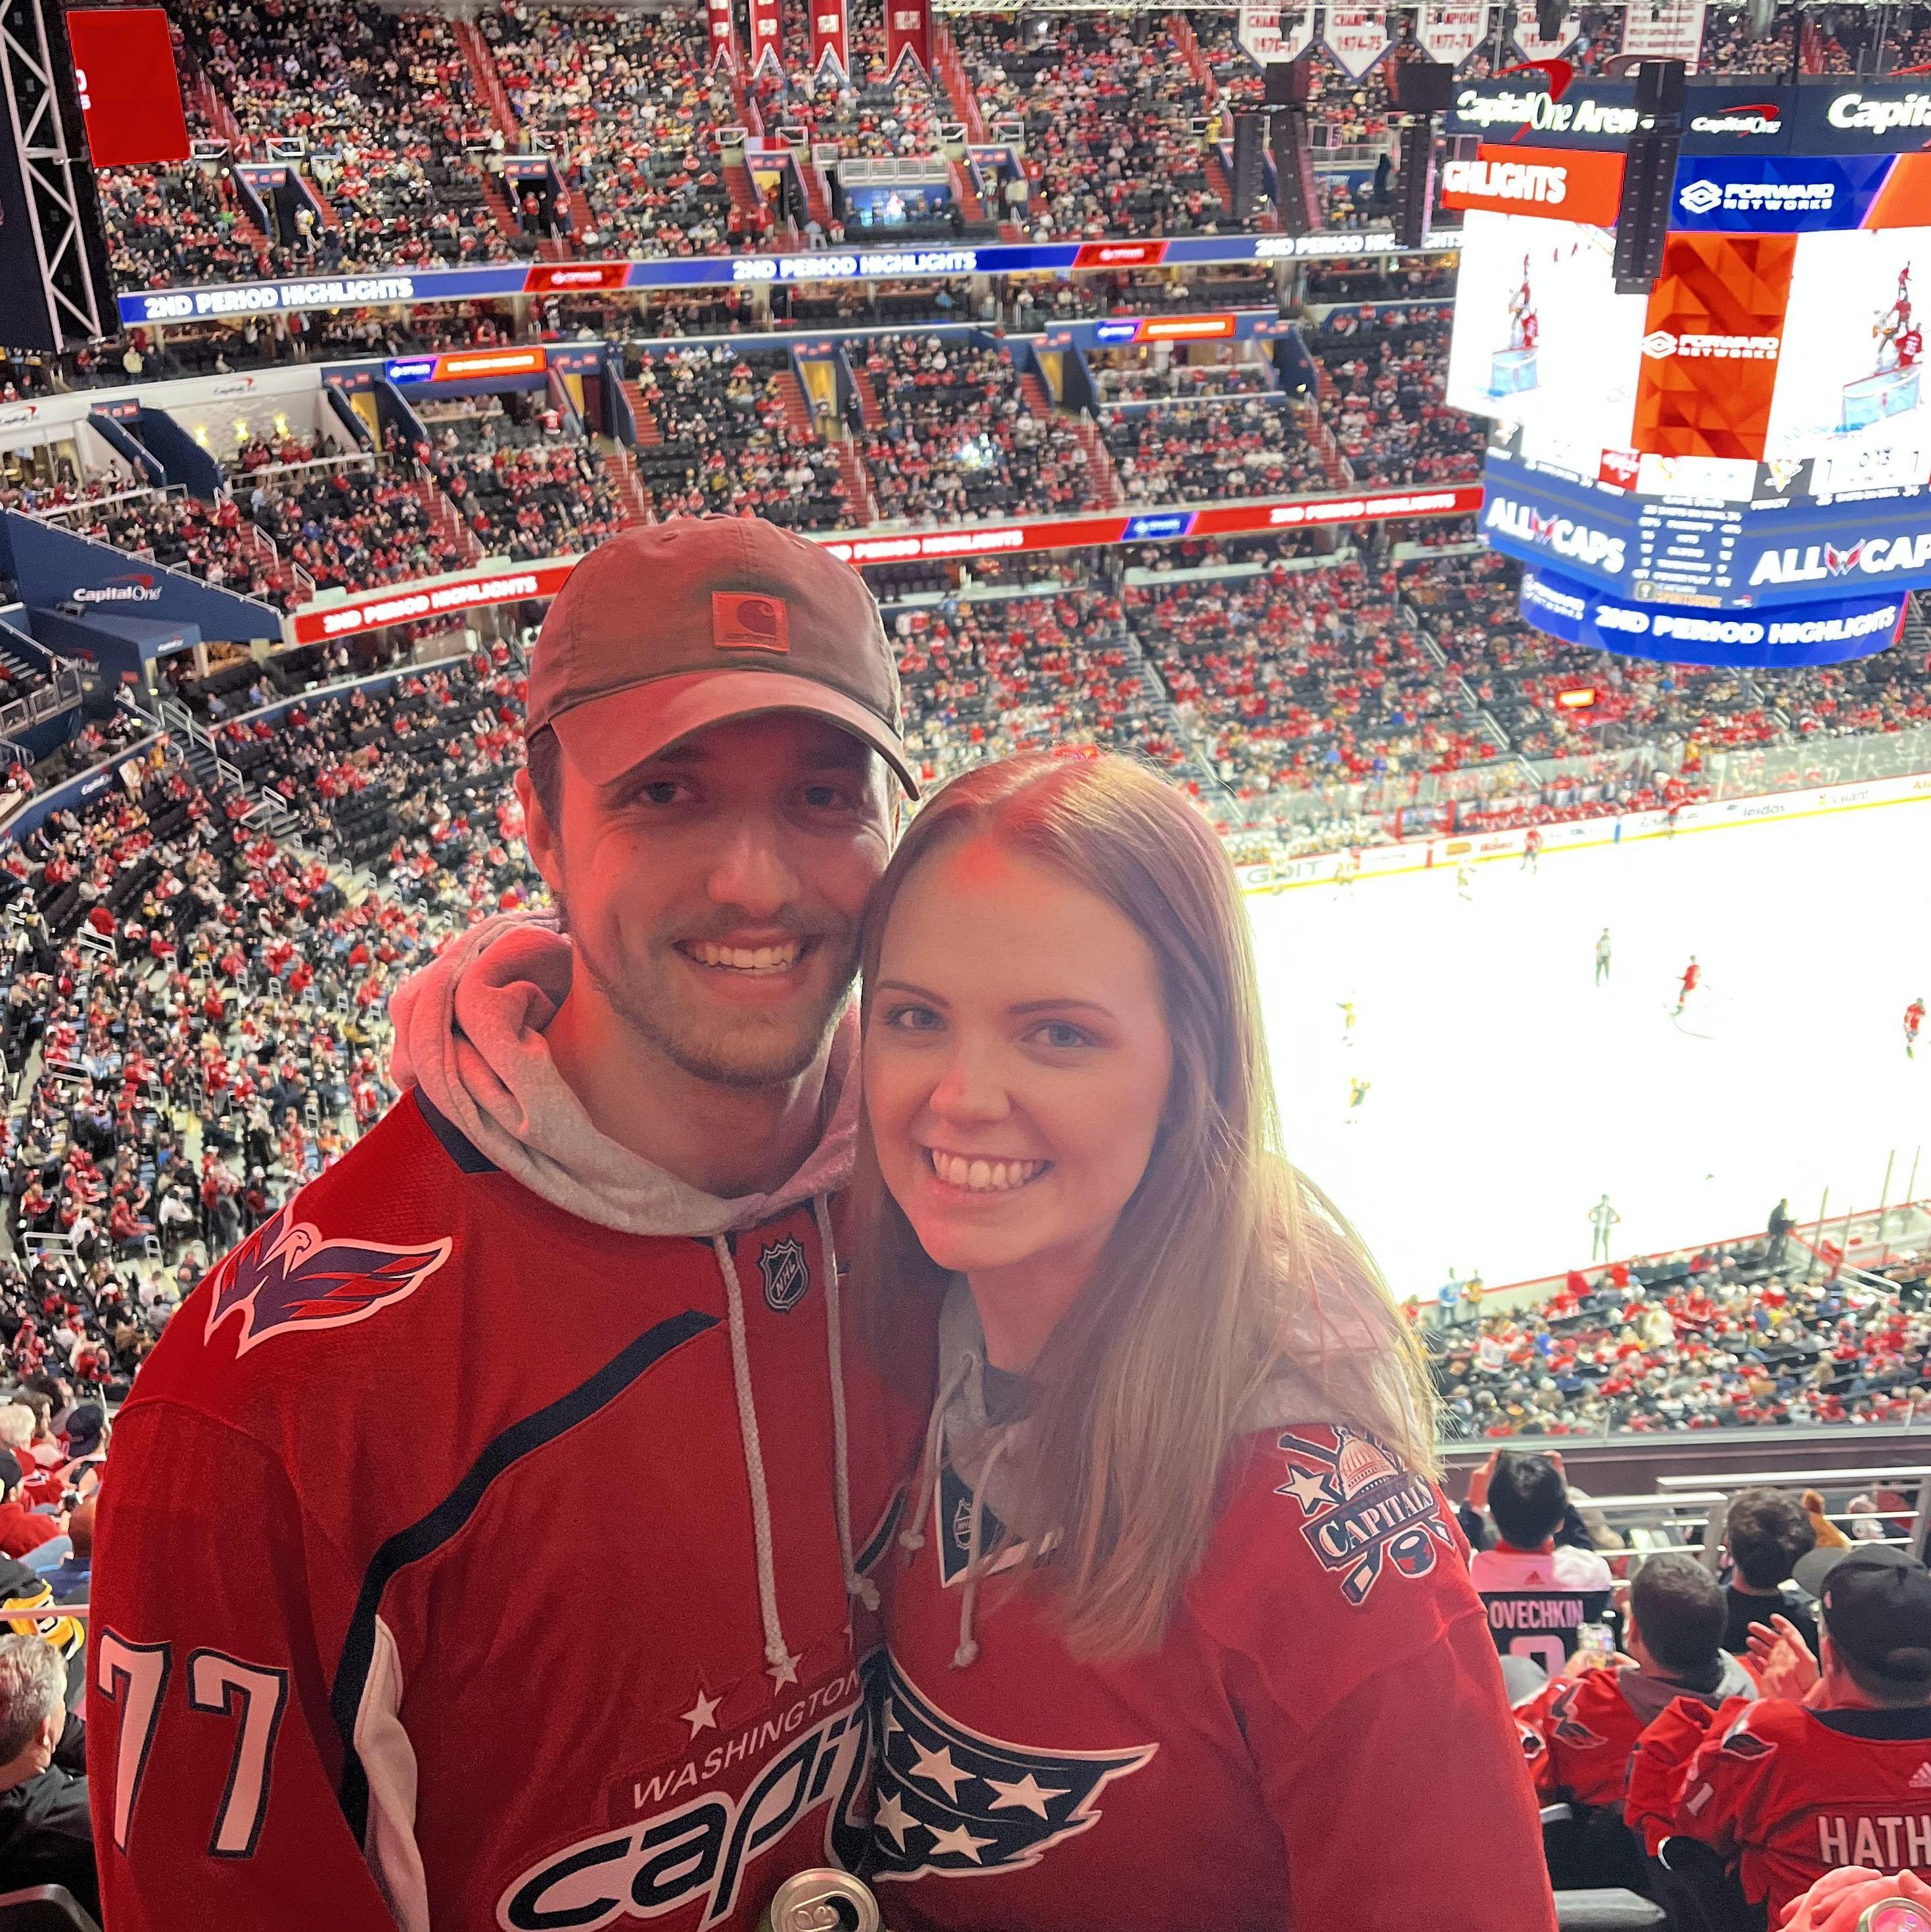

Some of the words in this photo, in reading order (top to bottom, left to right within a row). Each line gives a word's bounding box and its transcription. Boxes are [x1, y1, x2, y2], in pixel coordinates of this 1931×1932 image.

[1571, 100, 1655, 133] Aren
[1723, 199, 1833, 210] NETWORKS
[1725, 183, 1835, 199] FORWARD
[1255, 238, 1294, 257] 2ND
[1295, 235, 1364, 255] PERIOD
[732, 260, 778, 281] 2ND
[779, 256, 858, 279] PERIOD
[859, 252, 977, 274] HIGHLIGHTS
[144, 295, 193, 319] 2ND
[196, 287, 281, 314] PERIOD
[281, 277, 414, 306] HIGHLIGHTS
[1484, 496, 1536, 541] ALL
[1552, 519, 1627, 573] CAPS
[1748, 545, 1828, 586] ALL
[363, 594, 430, 624] PERIOD
[430, 575, 538, 609] HIGHLIGHTS
[1595, 605, 1649, 633] 2ND
[1653, 615, 1764, 644] PERIOD
[1768, 605, 1897, 645] HIGHLIGHTS
[776, 1260, 796, 1298] NHL
[1318, 1474, 1434, 1557] CAPITALS
[1489, 1599, 1585, 1629] OVECHKIN
[99, 1626, 287, 1859] 77
[633, 1668, 860, 1809] WASHINGTON
[1817, 1814, 1931, 1868] HATH
